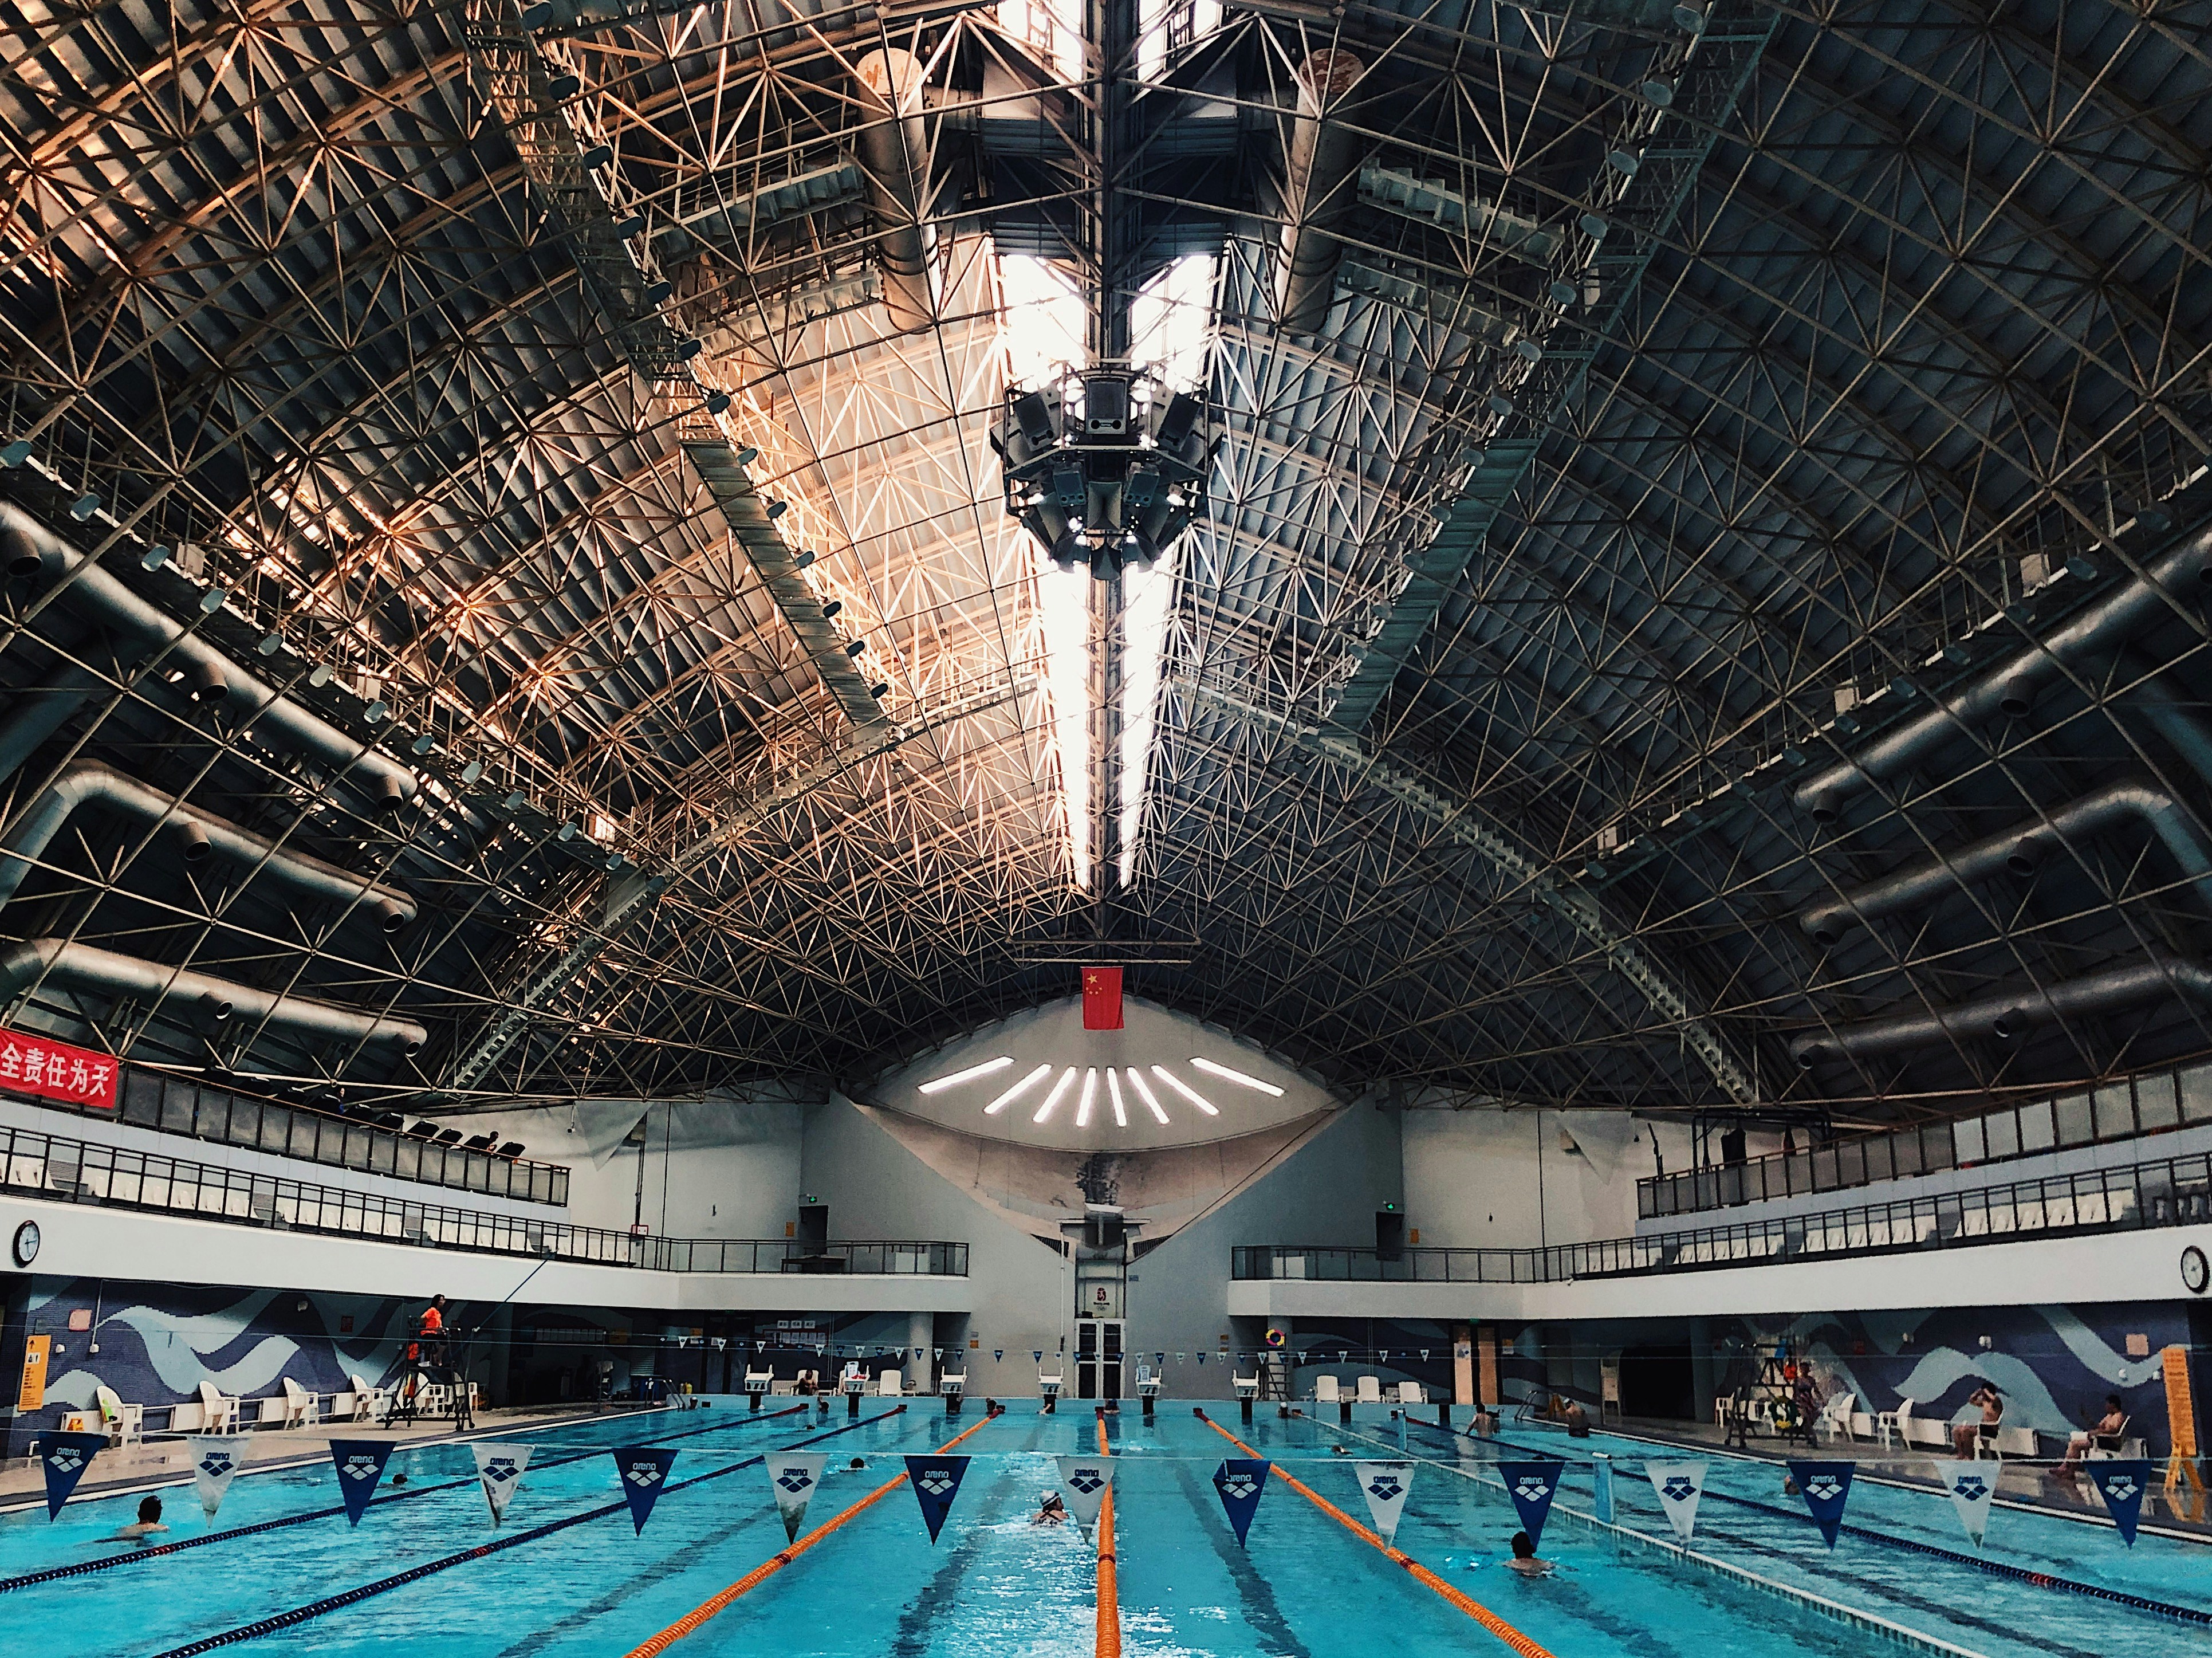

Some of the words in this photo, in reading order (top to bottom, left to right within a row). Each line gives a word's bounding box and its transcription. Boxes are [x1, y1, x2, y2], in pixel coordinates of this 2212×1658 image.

[0, 1042, 110, 1097] 全责任为天
[56, 1447, 80, 1456] arena
[206, 1452, 230, 1460] arena
[349, 1456, 374, 1464] arena
[490, 1457, 515, 1466] arena
[632, 1463, 656, 1471] arena
[783, 1468, 808, 1476] arena
[924, 1471, 949, 1479] arena
[1074, 1469, 1099, 1478] arena
[1373, 1476, 1398, 1484] arena
[1520, 1476, 1544, 1484] arena
[1666, 1476, 1690, 1485] arena
